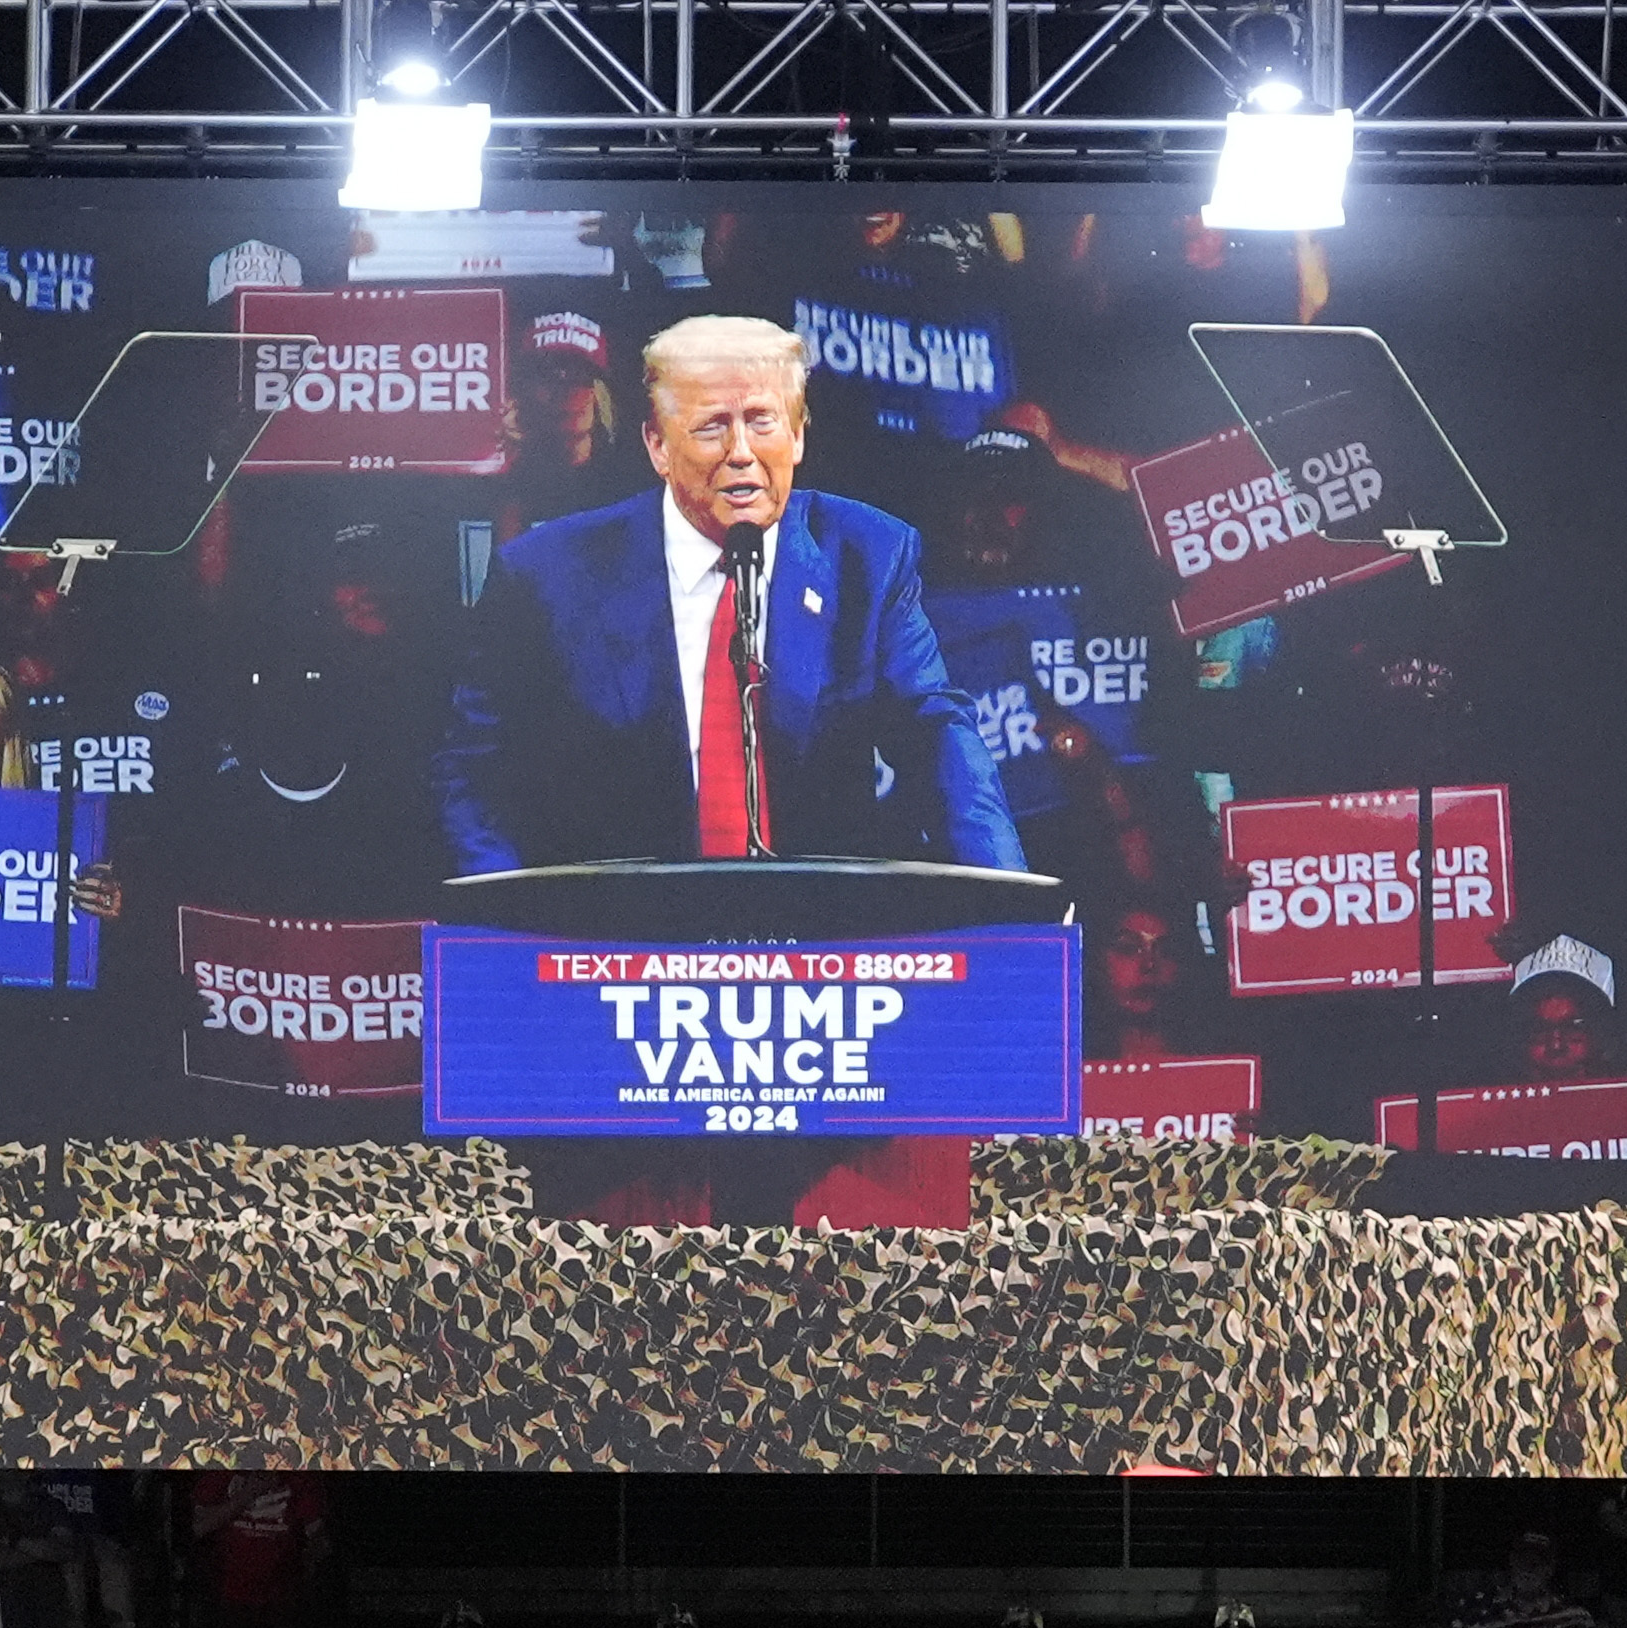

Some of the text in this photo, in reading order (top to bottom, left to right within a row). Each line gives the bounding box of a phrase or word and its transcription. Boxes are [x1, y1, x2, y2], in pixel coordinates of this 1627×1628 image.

[256, 344, 487, 371] SECURE OUR
[255, 372, 491, 412] BORDER
[21, 420, 80, 447] OUR
[350, 456, 394, 469] 2024
[1174, 467, 1383, 577] BORDER
[195, 961, 423, 999] SECURE OUR
[551, 955, 953, 980] TEXT ARIZONA TO 88022
[1351, 969, 1398, 986] 2024
[600, 986, 903, 1039] TRUMP
[635, 1041, 869, 1085] VANCE
[619, 1087, 885, 1102] MAKE AMERICA GREAT AGAIN!
[705, 1106, 798, 1131] 2024
